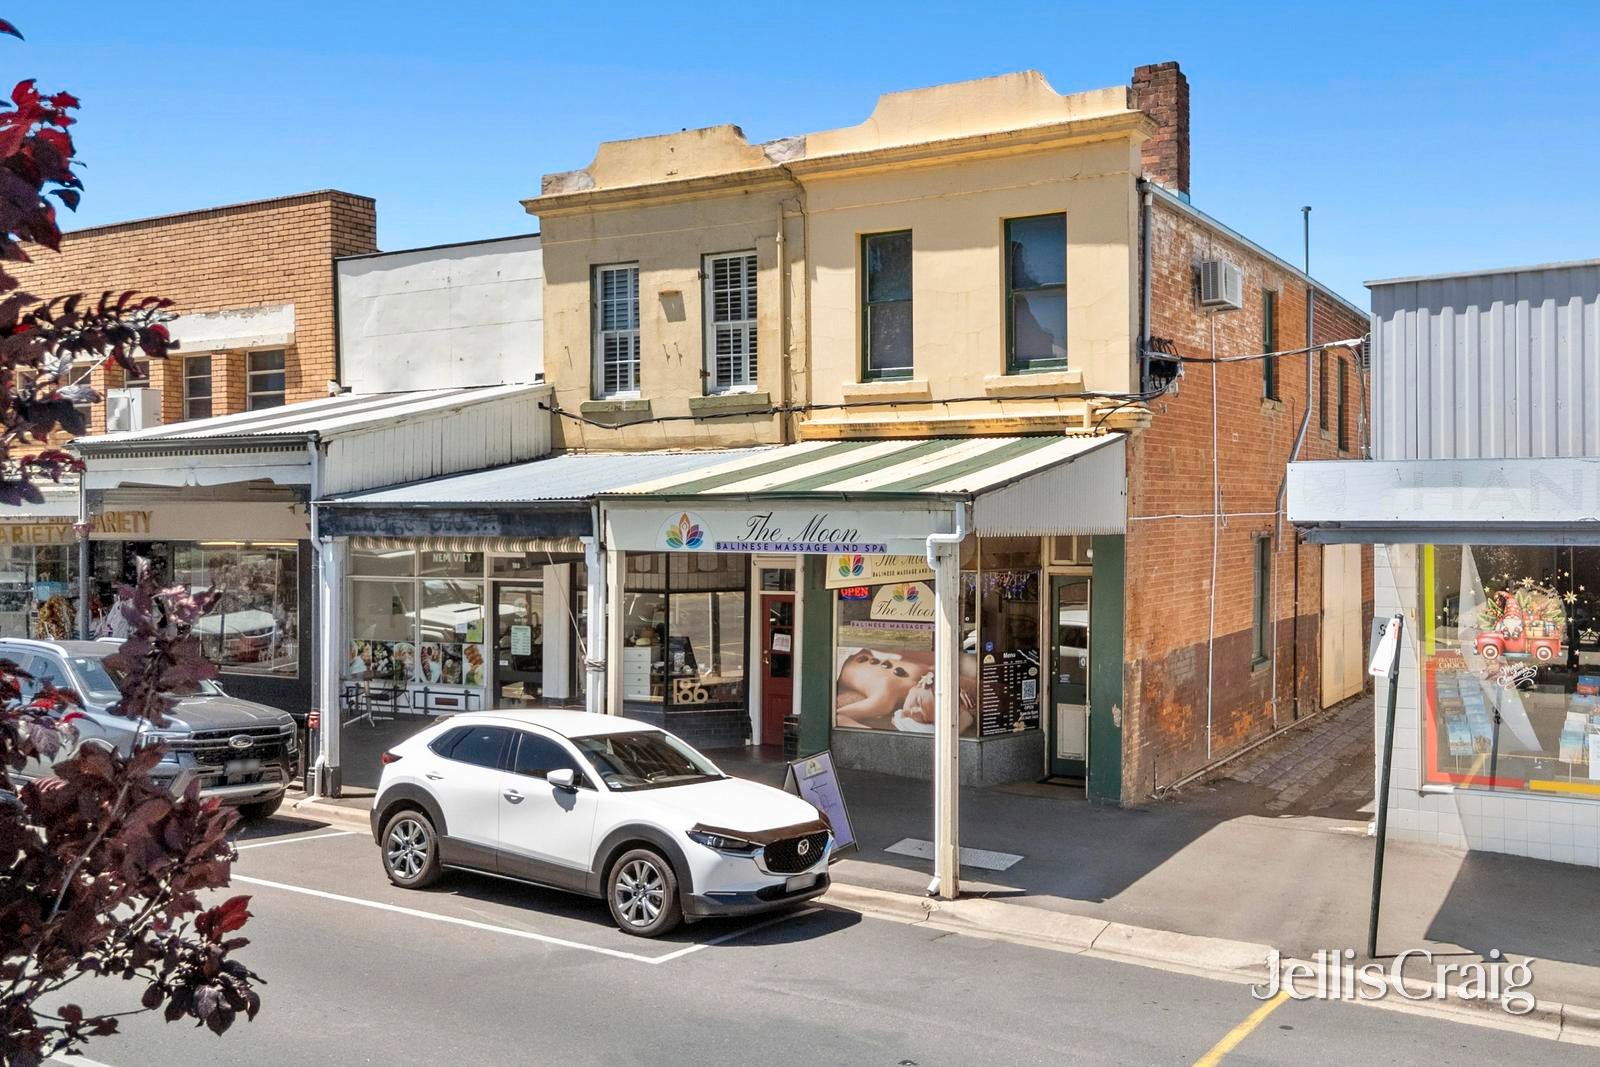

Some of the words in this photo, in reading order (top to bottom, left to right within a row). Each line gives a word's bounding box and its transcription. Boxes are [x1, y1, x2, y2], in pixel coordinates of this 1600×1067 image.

[737, 511, 783, 542] The
[788, 513, 861, 543] Moon
[716, 542, 769, 550] BALINESE
[775, 543, 827, 552] MASSAGE
[834, 544, 858, 552] AND
[865, 545, 885, 553] SPA
[453, 553, 472, 562] VIET
[897, 568, 917, 576] MASSAGE
[841, 587, 868, 597] OPEN
[871, 599, 897, 616] The
[851, 621, 886, 629] BALINESE
